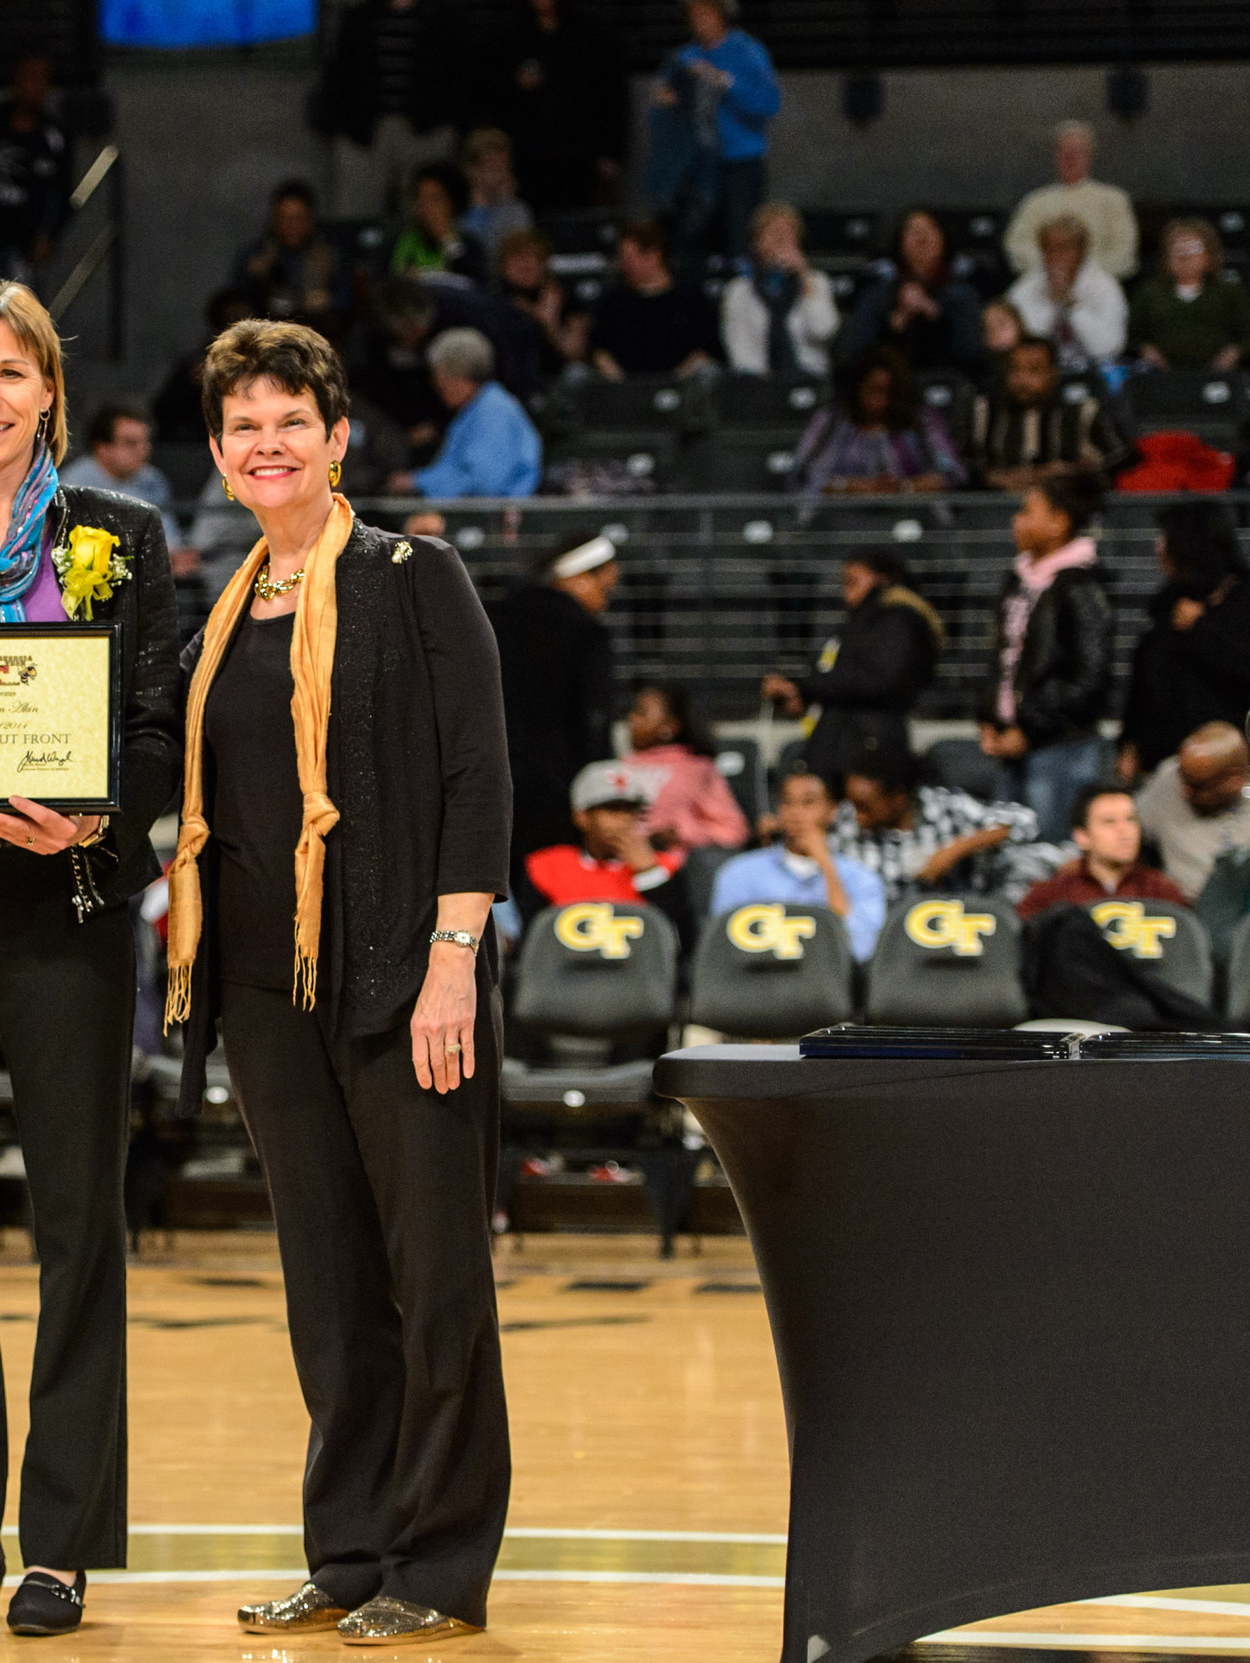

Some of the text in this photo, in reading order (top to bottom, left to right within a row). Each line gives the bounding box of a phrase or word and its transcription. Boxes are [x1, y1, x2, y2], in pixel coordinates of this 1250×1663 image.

[3, 720, 29, 731] 2014
[23, 733, 72, 745] FRONT
[554, 902, 644, 959] GT
[726, 903, 817, 960] GT
[904, 899, 997, 957] GT
